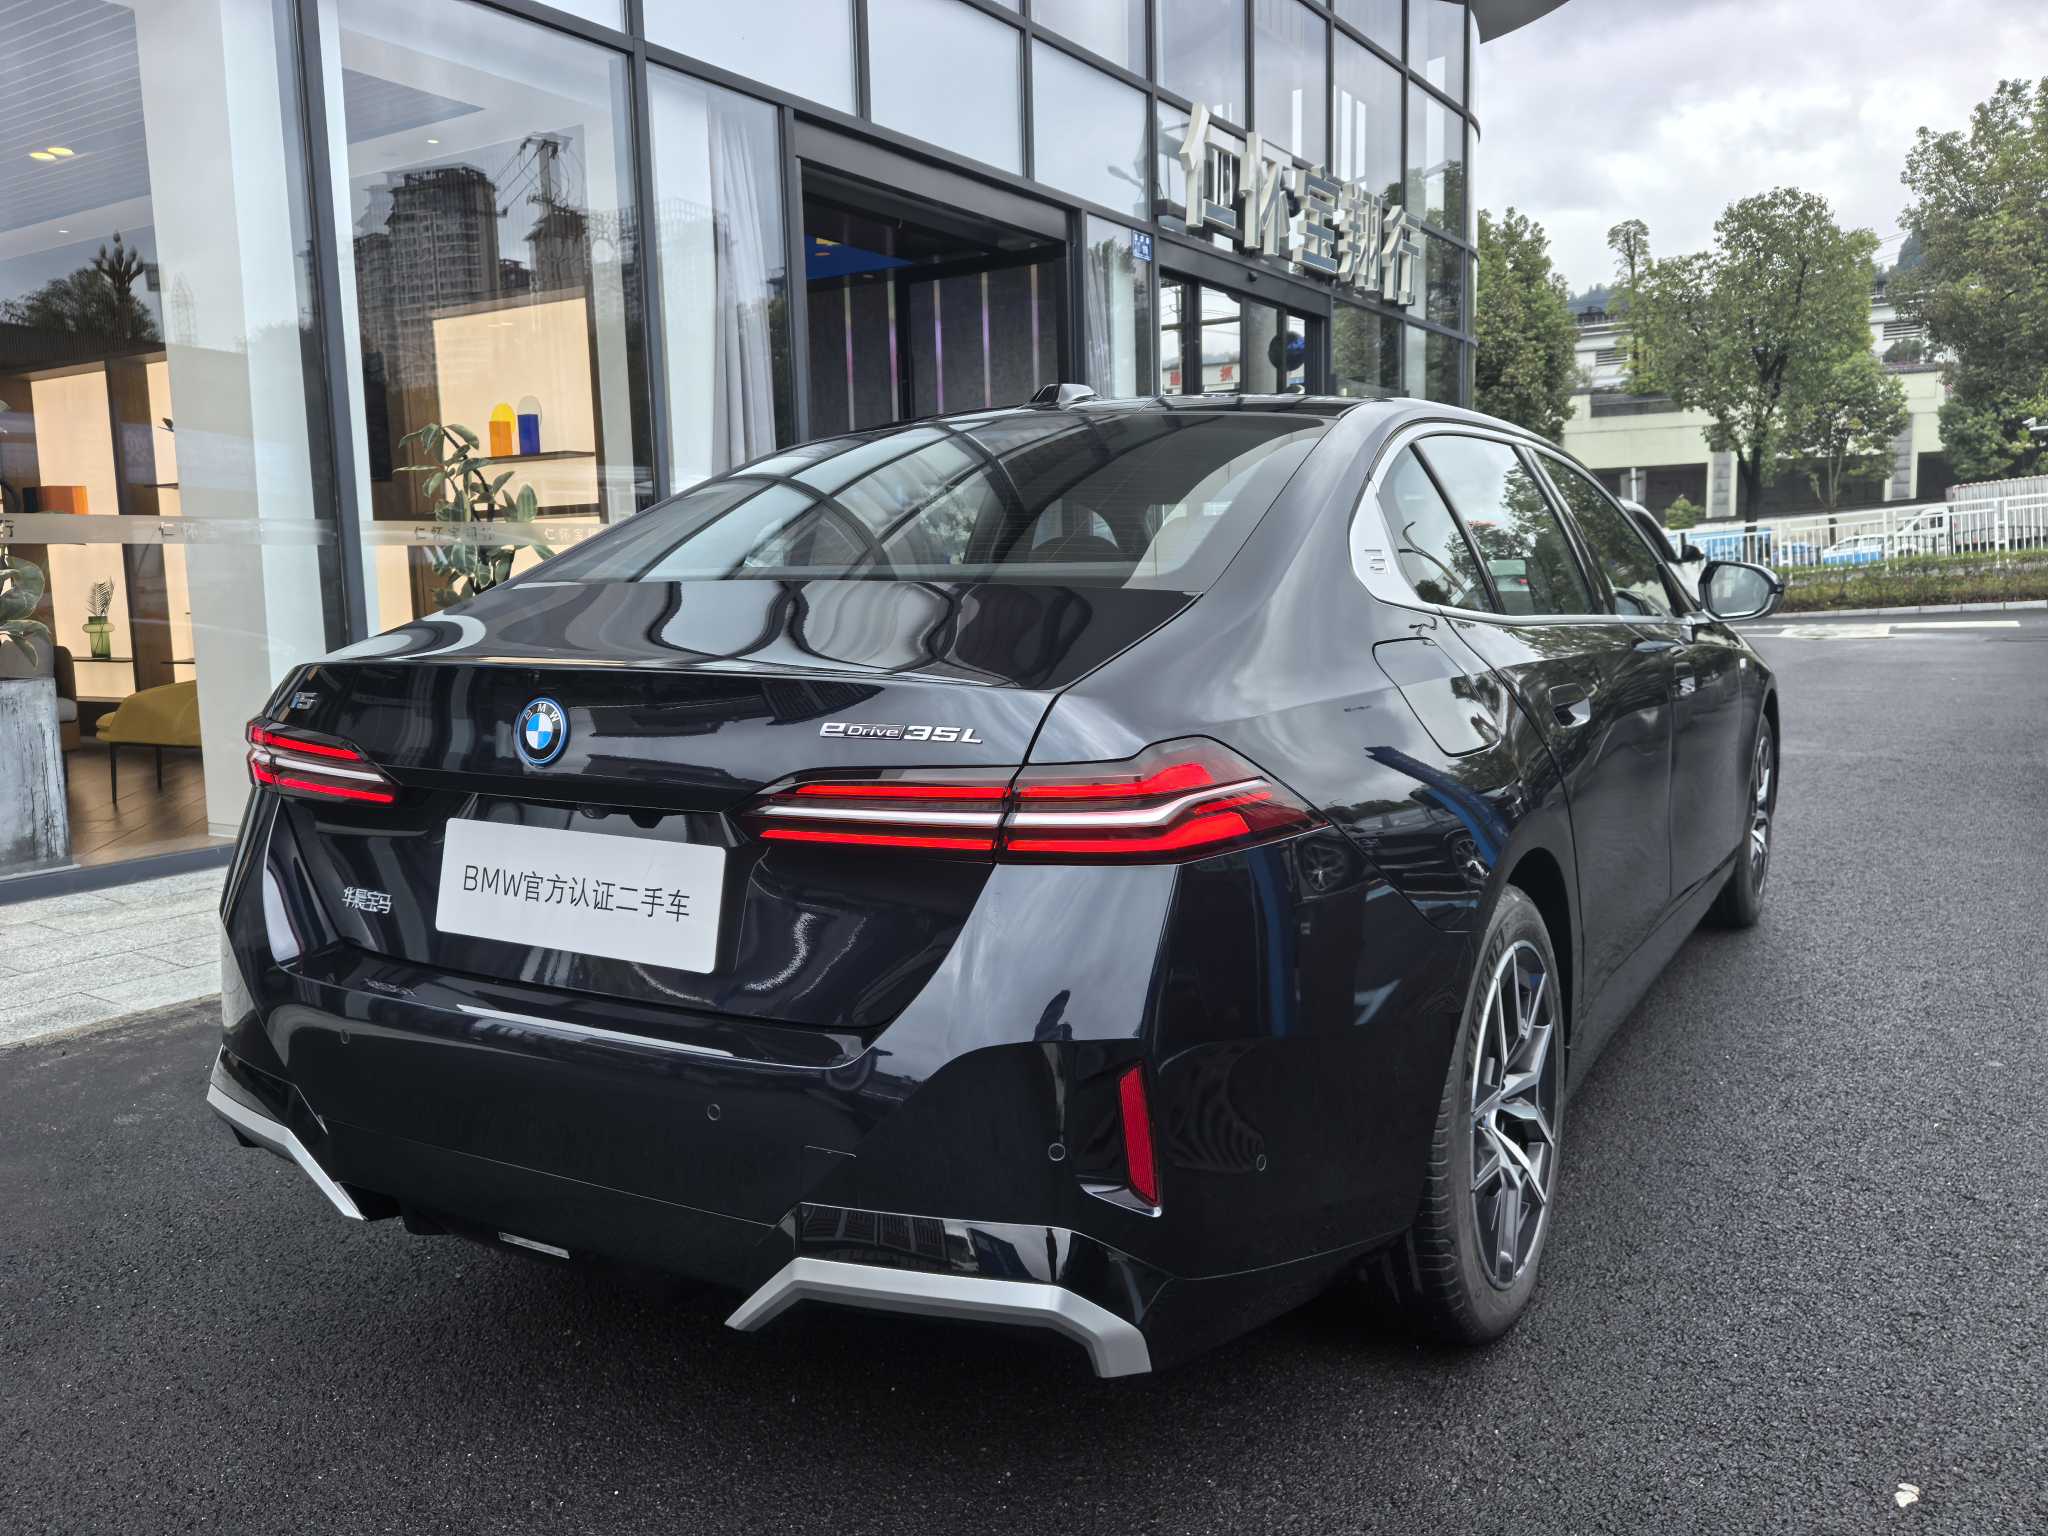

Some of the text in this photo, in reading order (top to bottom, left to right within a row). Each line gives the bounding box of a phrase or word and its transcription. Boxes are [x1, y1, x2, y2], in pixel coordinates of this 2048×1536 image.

[523, 703, 561, 722] BMW
[341, 886, 392, 914] 华晨宝马
[463, 864, 691, 922] BMW官方认证二手车
